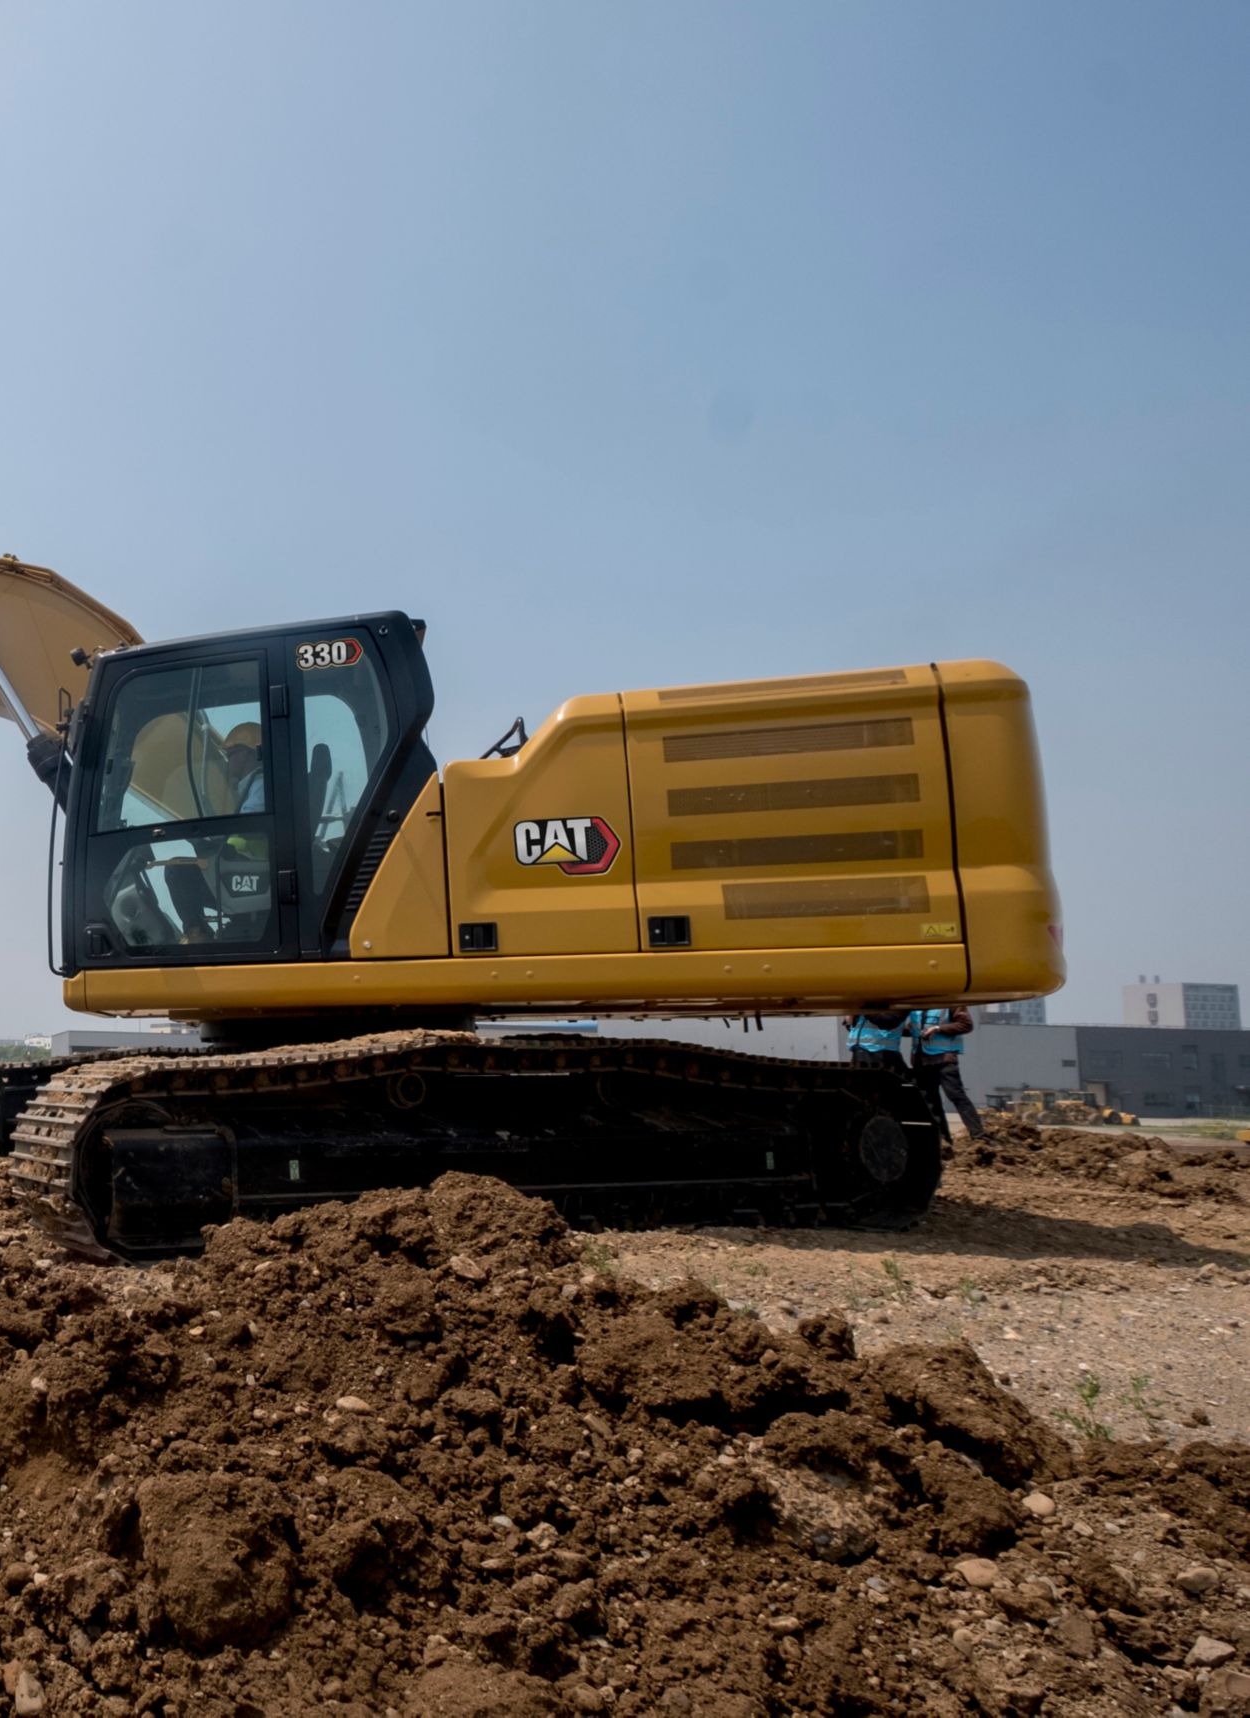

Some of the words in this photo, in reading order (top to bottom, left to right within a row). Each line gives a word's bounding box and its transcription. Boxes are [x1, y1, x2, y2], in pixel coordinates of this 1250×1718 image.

[298, 641, 347, 668] 330
[515, 818, 592, 865] CAT
[232, 875, 259, 892] CAT
